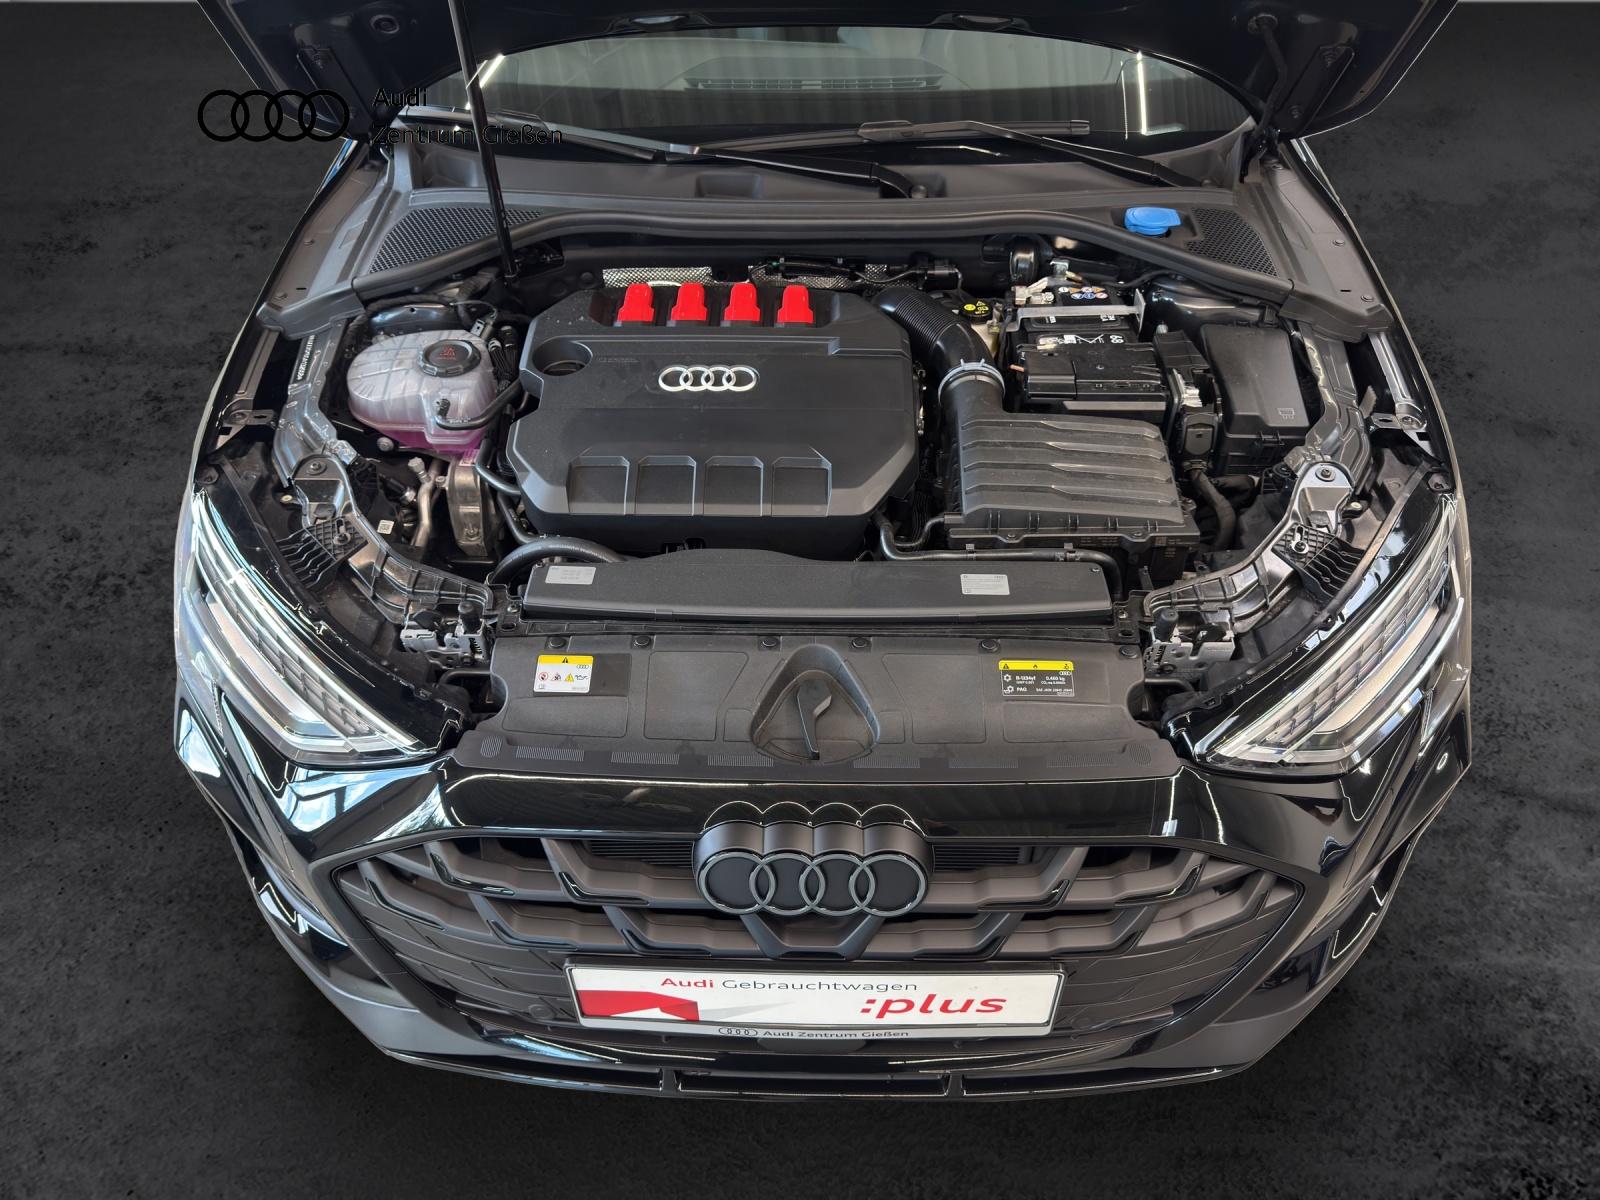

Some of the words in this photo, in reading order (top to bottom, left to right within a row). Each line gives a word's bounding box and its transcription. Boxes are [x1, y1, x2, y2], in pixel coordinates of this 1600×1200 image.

[661, 977, 714, 988] Audi
[722, 979, 917, 992] Gebrauchtwagen
[860, 994, 1007, 1019] :plus
[763, 1029, 794, 1038] Audi
[798, 1029, 858, 1038] Zentrum
[861, 1029, 909, 1038] Gießen
